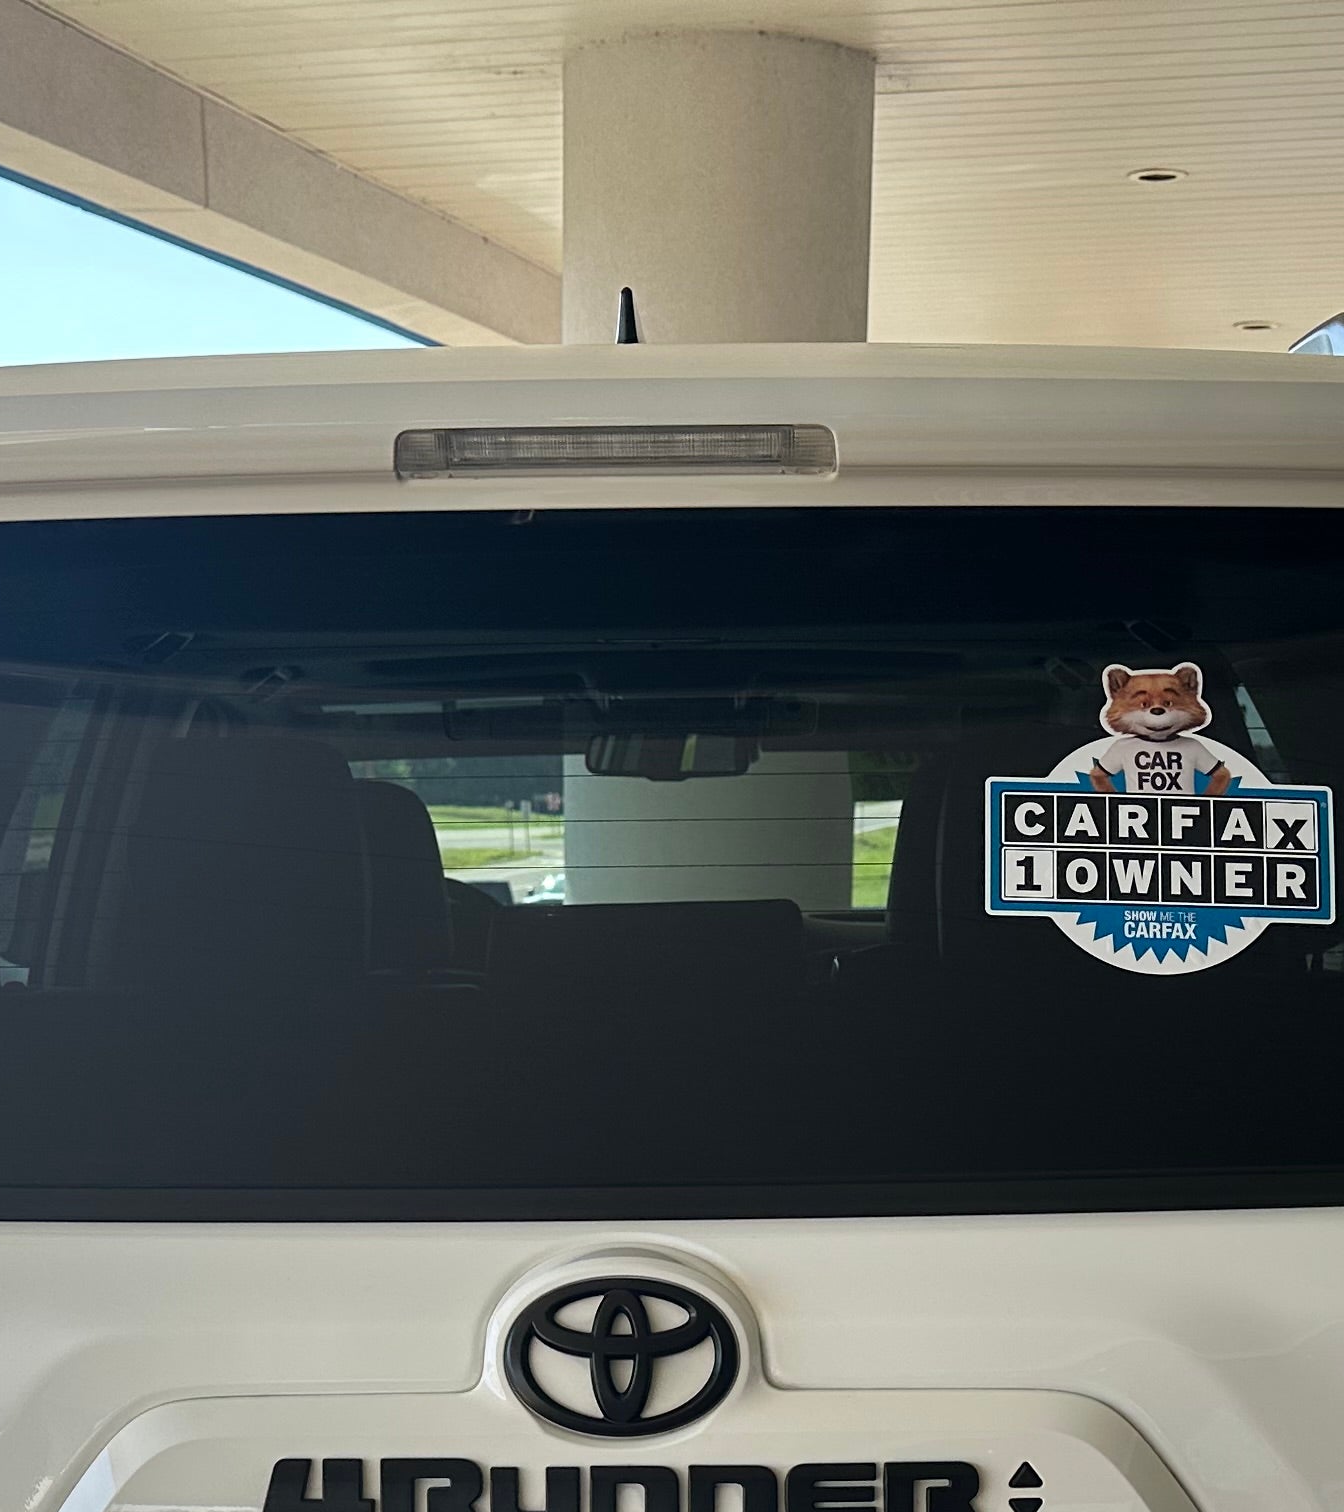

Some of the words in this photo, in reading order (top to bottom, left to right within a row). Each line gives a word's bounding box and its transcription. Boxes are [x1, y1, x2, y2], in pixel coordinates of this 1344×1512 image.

[1134, 751, 1183, 770] CAR
[1137, 772, 1183, 791] FOX
[1013, 801, 1309, 849] CARFAX
[1124, 910, 1157, 921] SHOW
[1160, 911, 1175, 922] ME
[1178, 911, 1197, 923] THE
[1123, 922, 1197, 940] CARFAX
